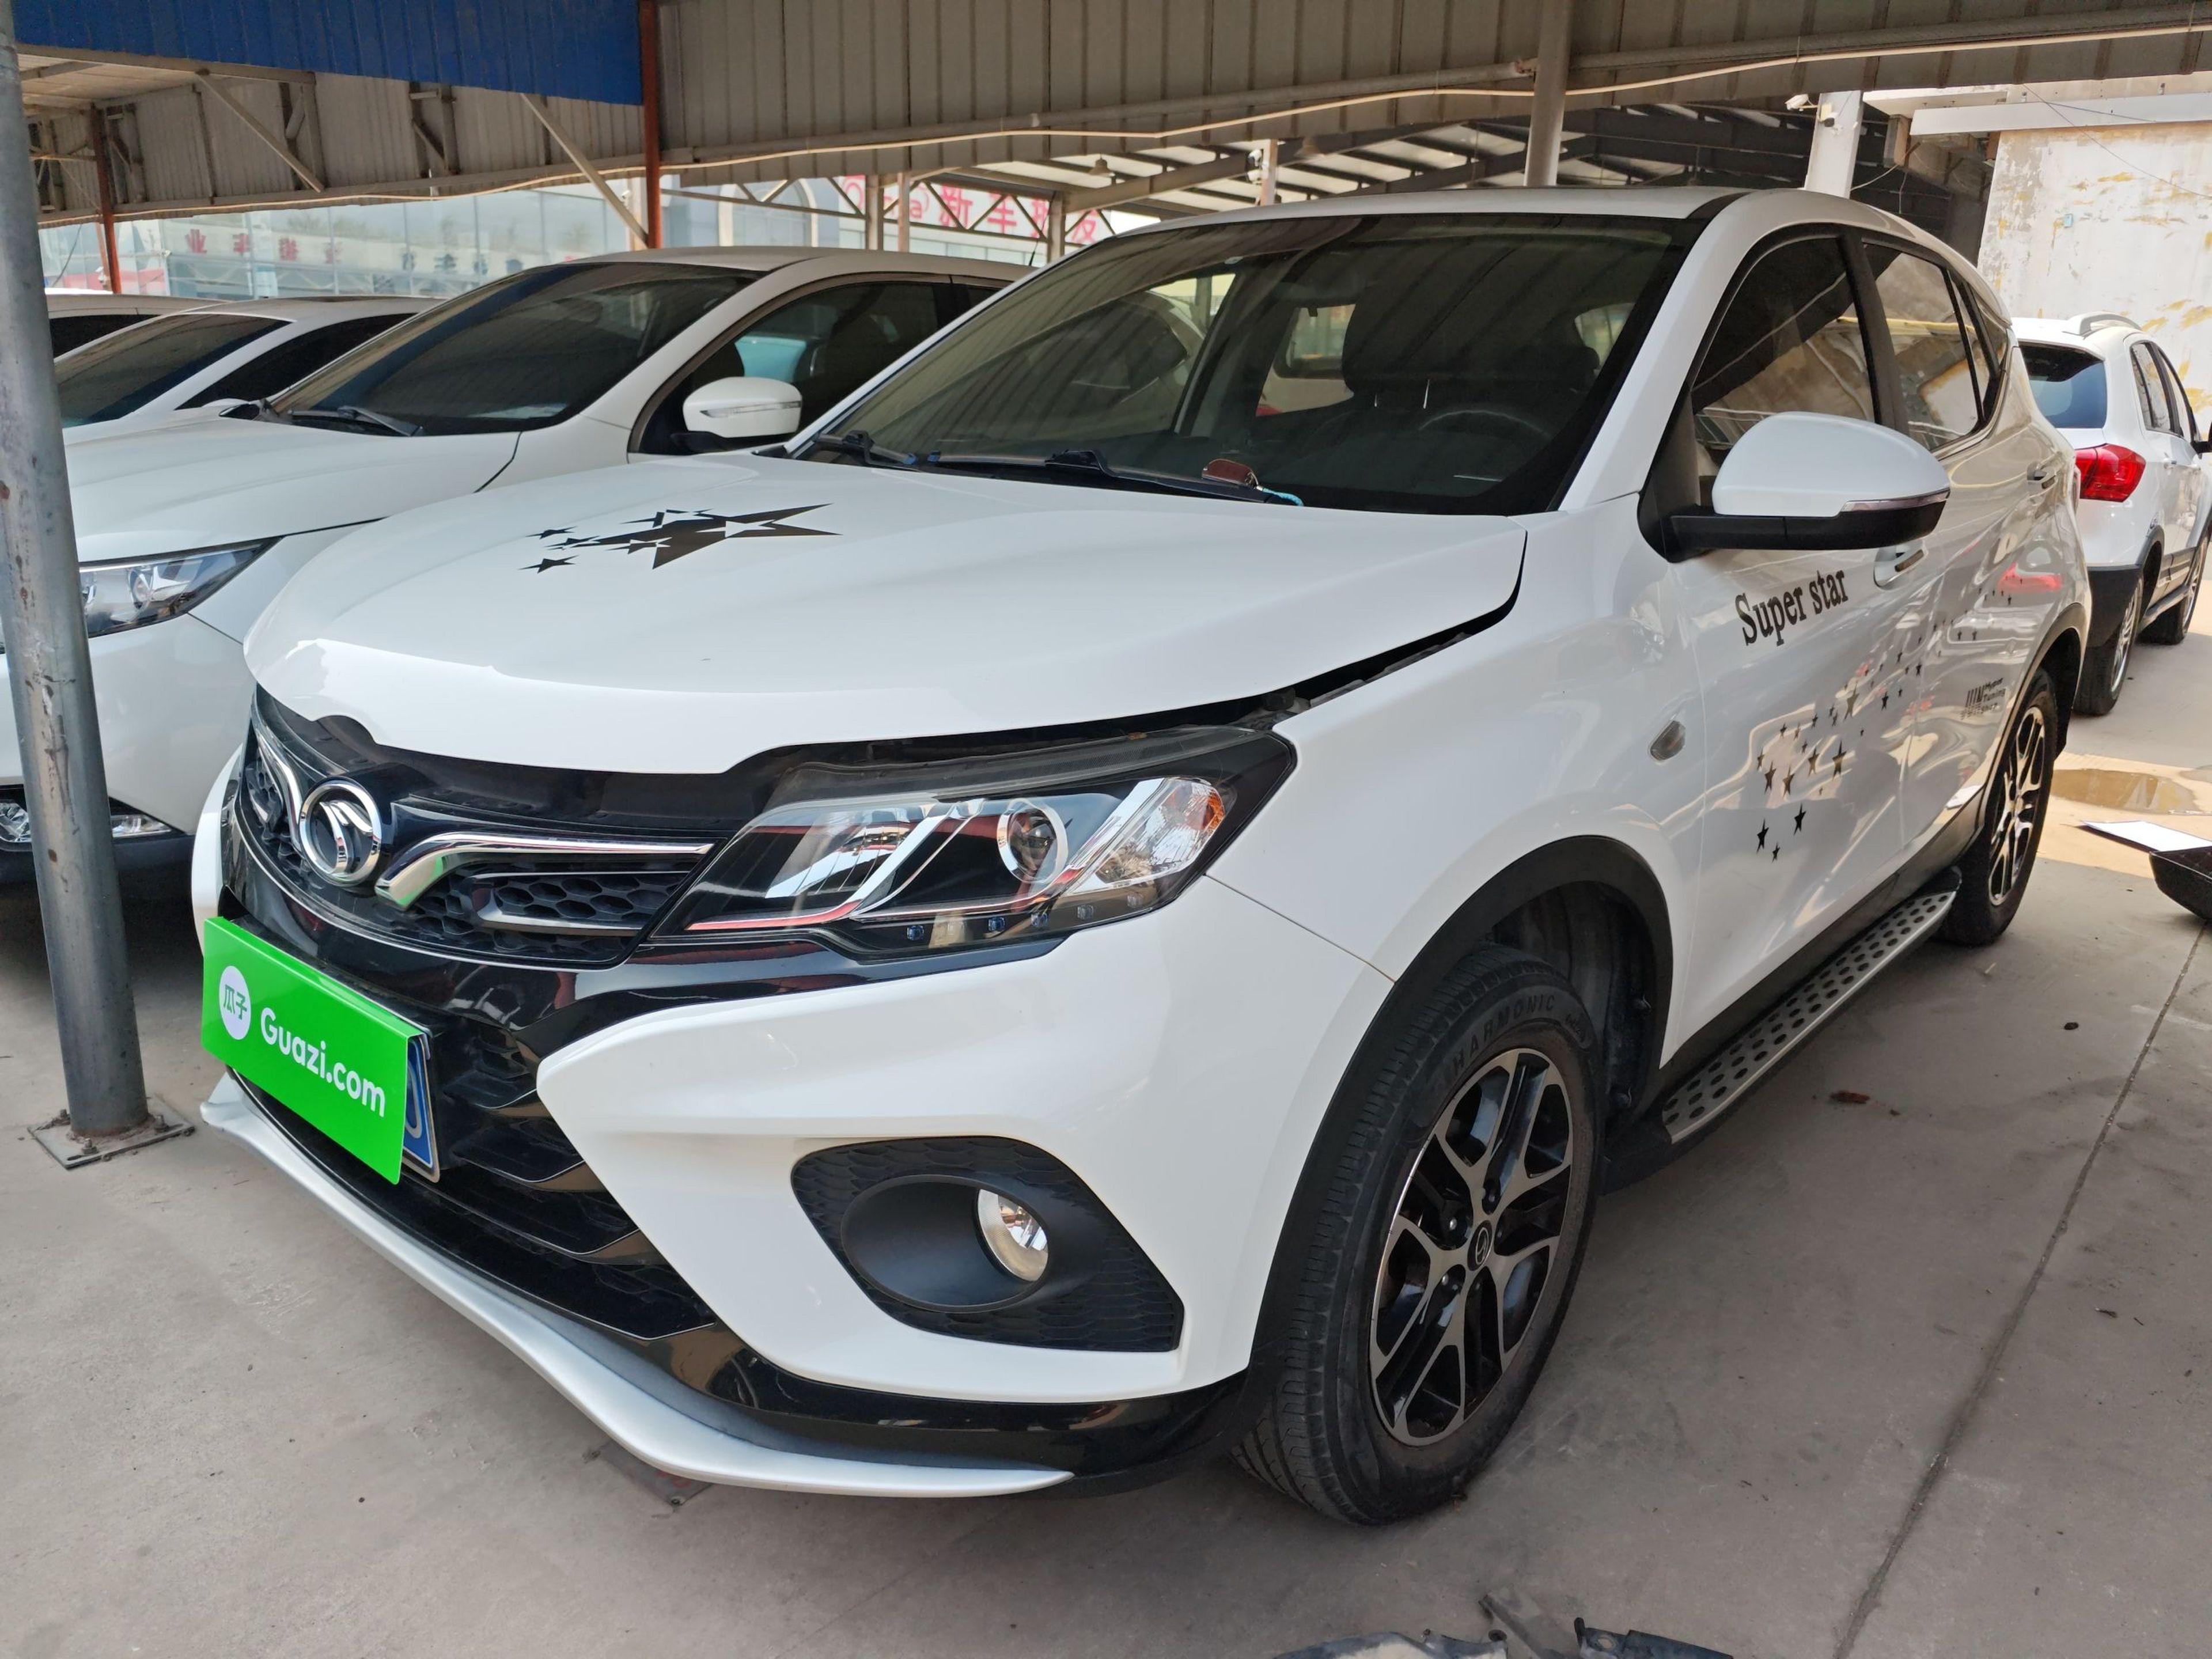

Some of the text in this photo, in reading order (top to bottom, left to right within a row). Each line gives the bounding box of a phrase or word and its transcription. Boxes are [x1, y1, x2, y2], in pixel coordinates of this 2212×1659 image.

[1735, 570, 1849, 647] Super star
[223, 984, 247, 1020] 瓜子
[260, 1007, 386, 1118] Guazi.com
